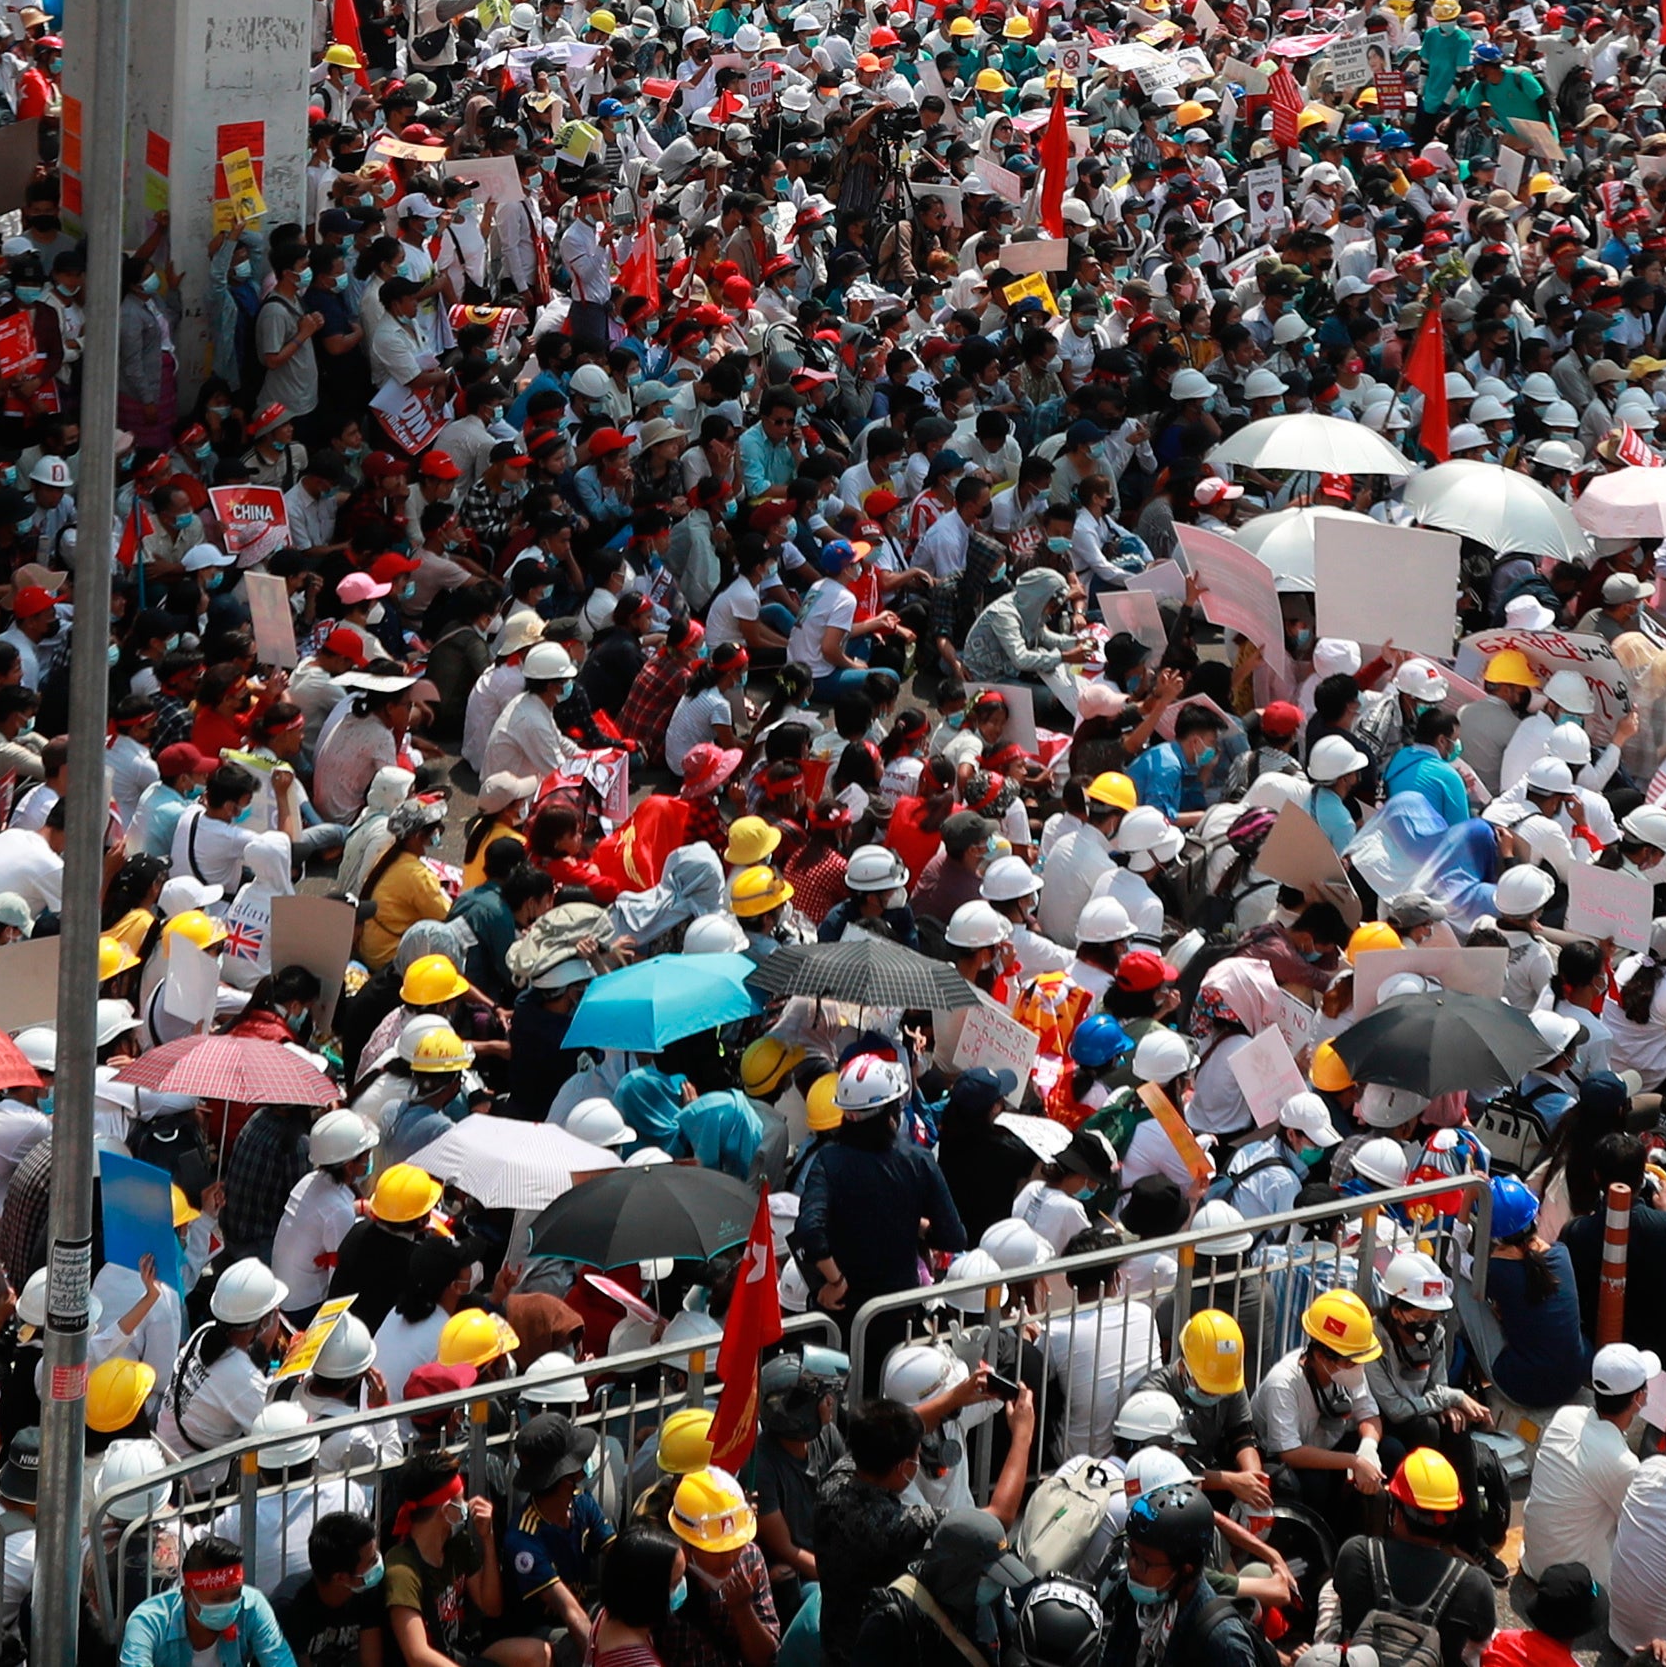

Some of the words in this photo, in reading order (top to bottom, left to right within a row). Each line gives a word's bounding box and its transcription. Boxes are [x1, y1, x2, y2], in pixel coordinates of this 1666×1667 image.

[1139, 72, 1179, 90] REJECT
[1335, 69, 1366, 83] REJECT
[750, 79, 771, 98] CDM
[232, 504, 275, 521] CHINA
[19, 1452, 39, 1465] NIK
[1032, 1583, 1103, 1631] PRESS
